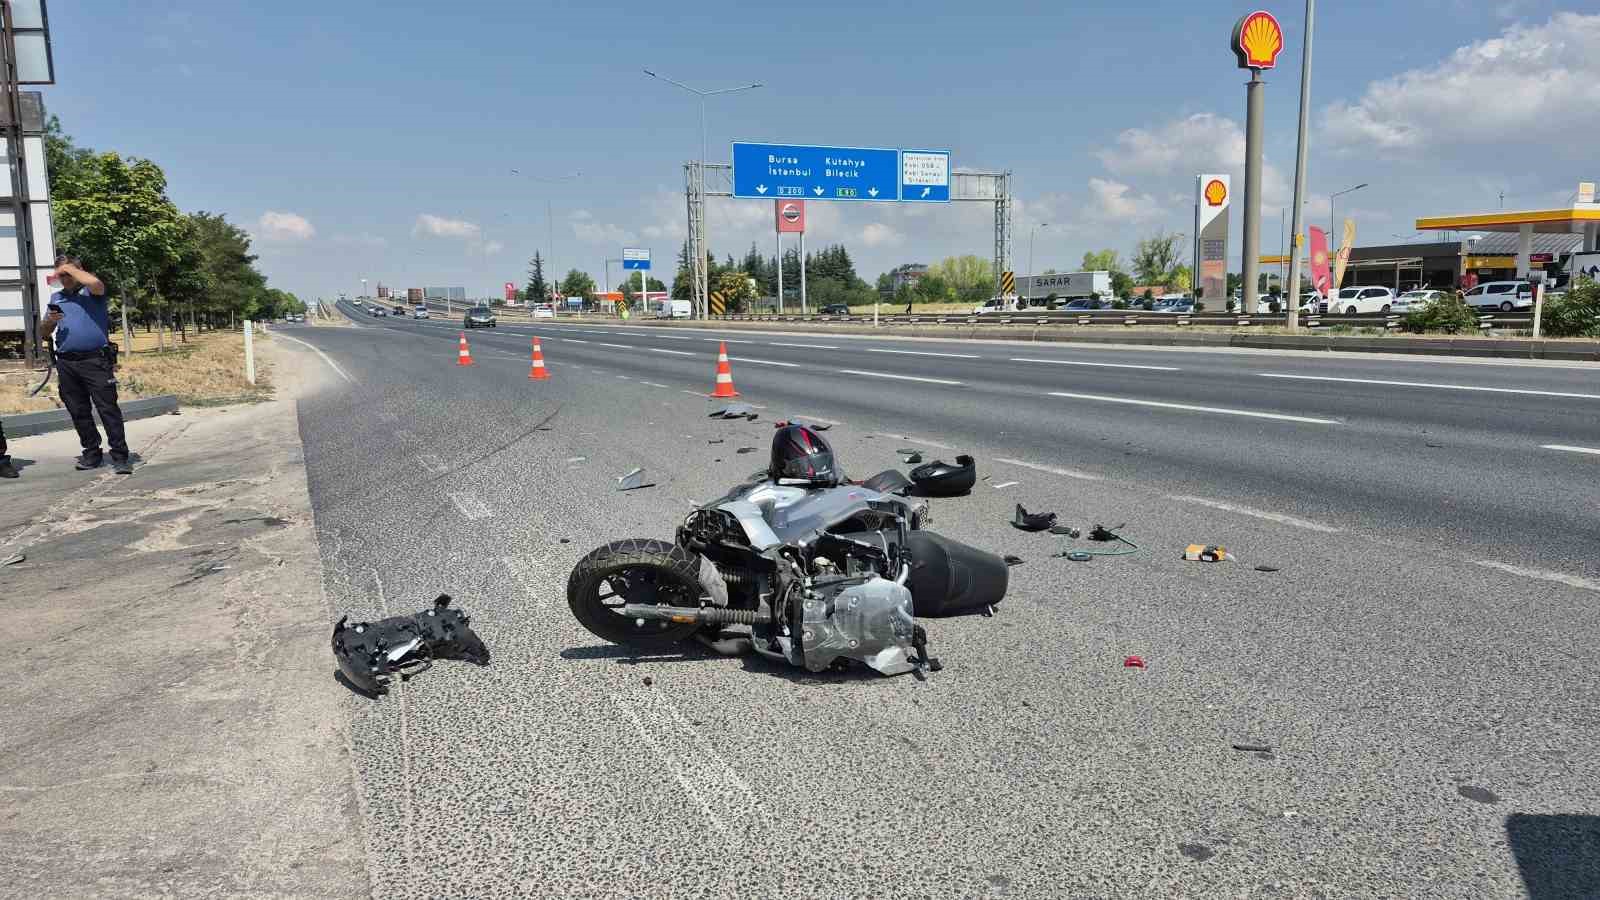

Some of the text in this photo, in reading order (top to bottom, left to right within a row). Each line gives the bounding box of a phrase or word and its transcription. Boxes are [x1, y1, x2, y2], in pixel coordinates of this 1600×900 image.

[768, 154, 798, 164] Bursa
[826, 169, 859, 178] Bilecik
[1036, 277, 1070, 287] SARAR
